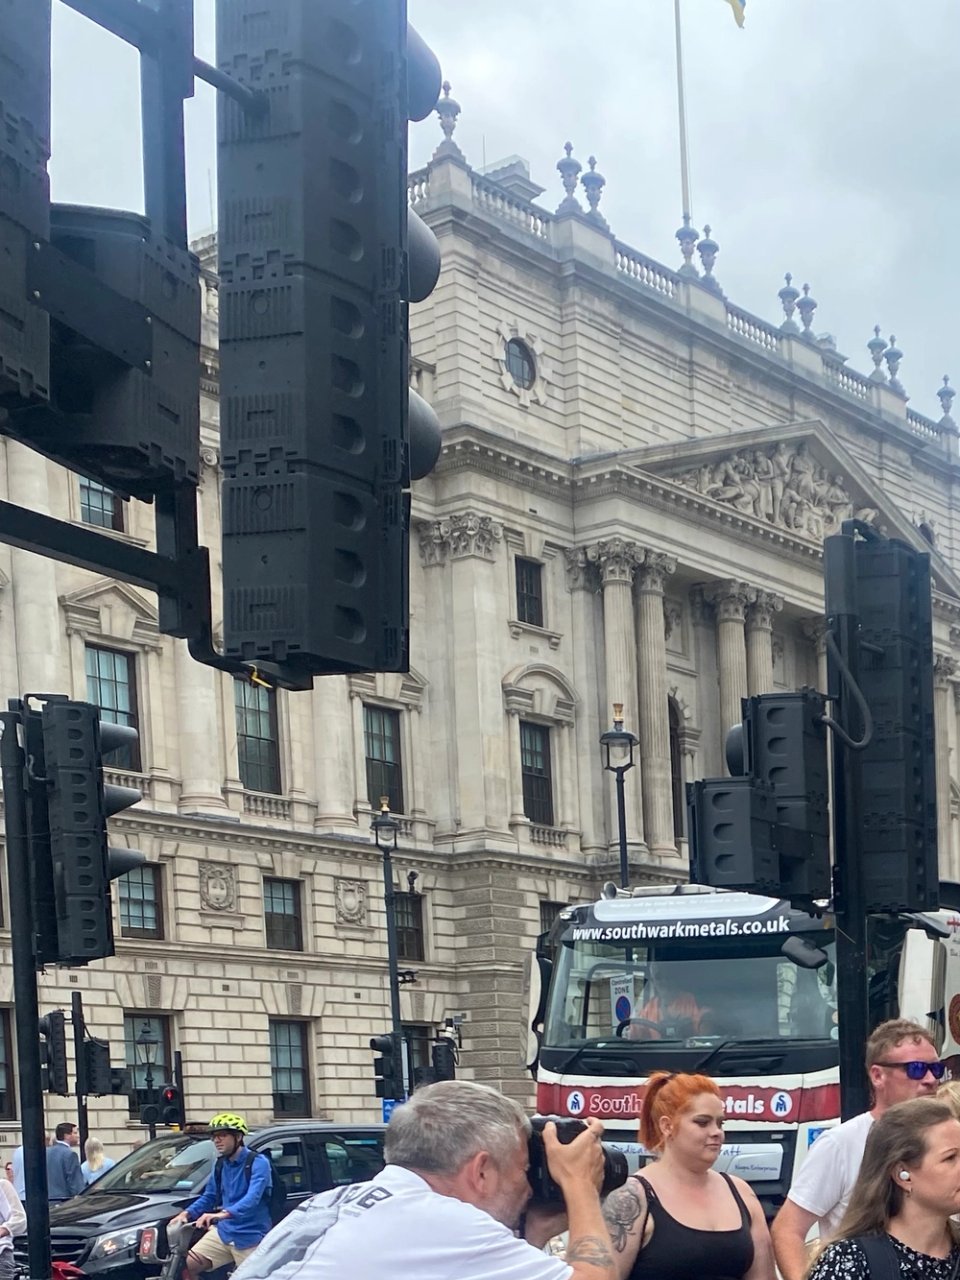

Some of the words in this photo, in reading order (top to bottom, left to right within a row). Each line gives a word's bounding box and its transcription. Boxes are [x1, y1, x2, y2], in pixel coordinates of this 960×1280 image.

[572, 916, 790, 941] www.southwarkmetals.co.uk
[615, 986, 630, 995] ZONE
[589, 1092, 642, 1113] South
